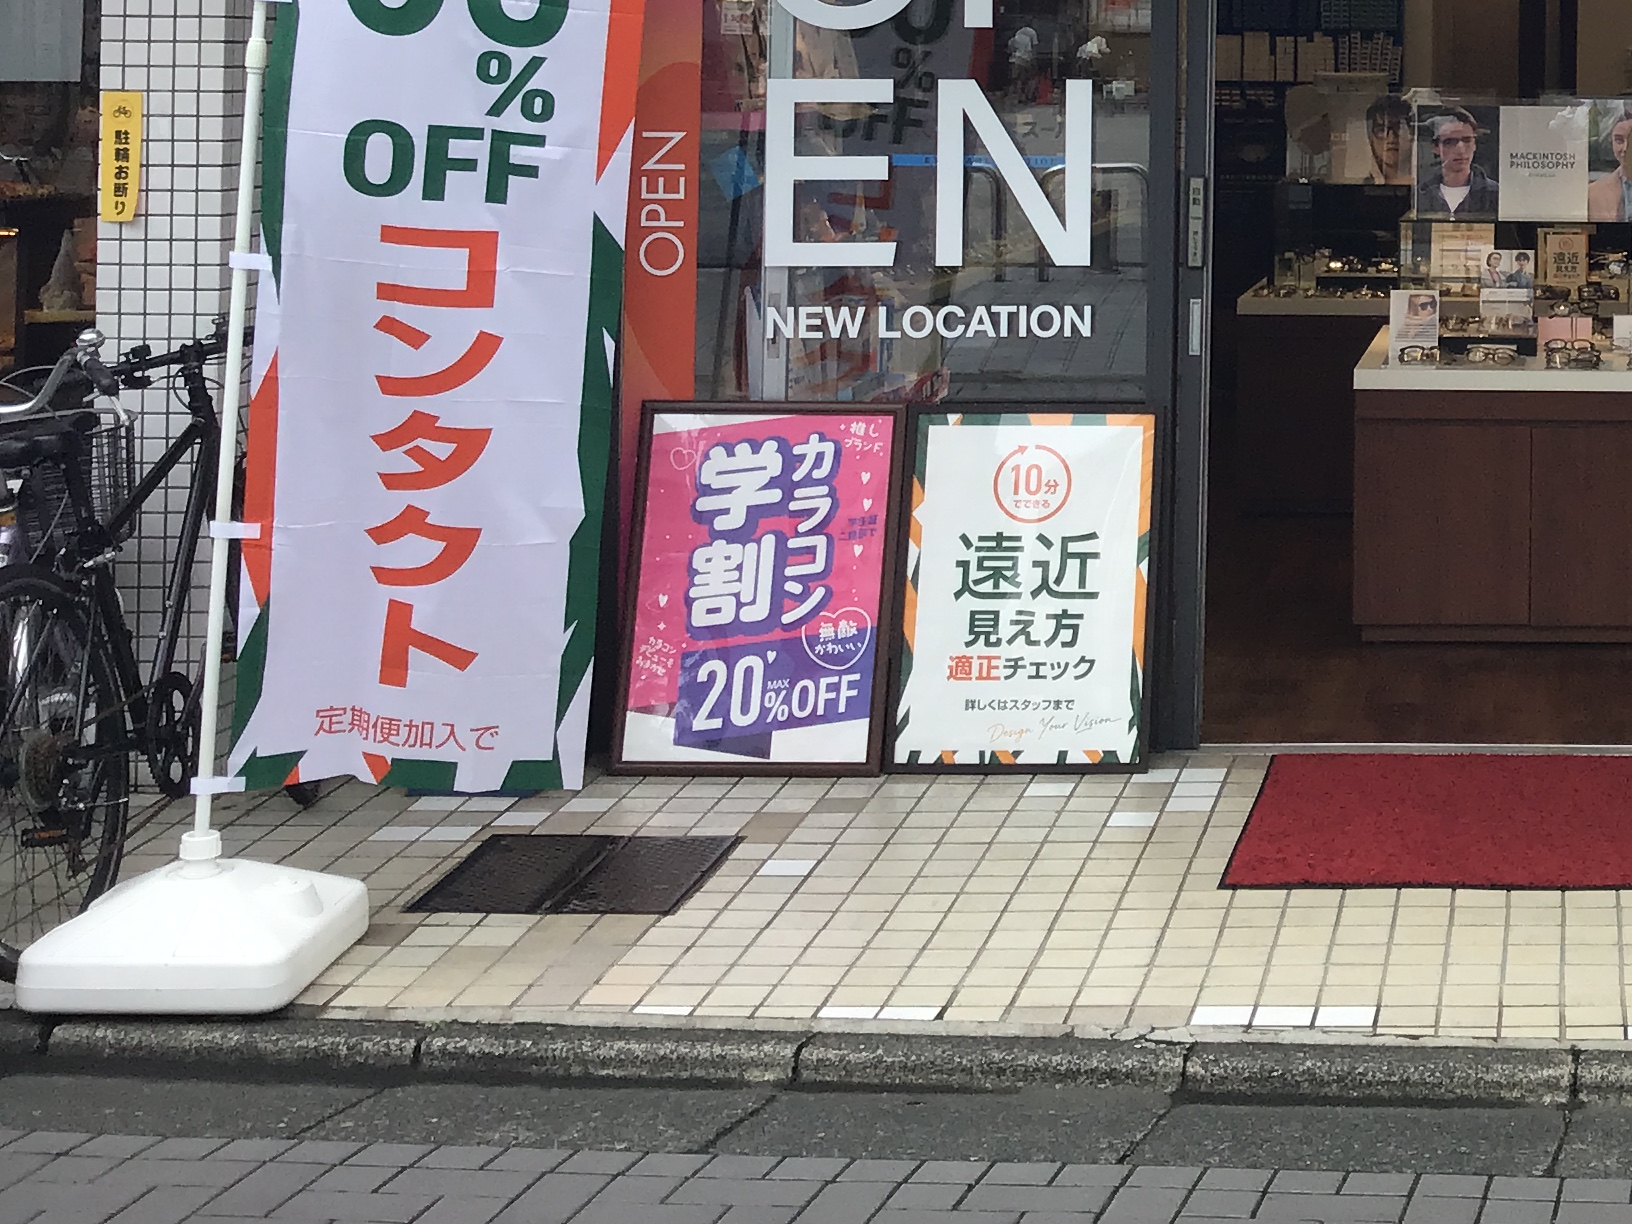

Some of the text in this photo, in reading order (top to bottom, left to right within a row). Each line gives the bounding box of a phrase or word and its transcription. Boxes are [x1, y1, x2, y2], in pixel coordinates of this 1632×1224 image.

[475, 51, 555, 123] %
[114, 129, 130, 216] 駐輪お断り
[343, 119, 547, 205] OFF
[764, 78, 1093, 267] EN
[1509, 152, 1576, 160] MACKINTOSH
[1509, 160, 1576, 169] PHILOSOPHY
[638, 131, 686, 276] OPEN
[766, 305, 1093, 339] NEW LOCATION
[365, 225, 504, 688] コンタクト
[1010, 463, 1060, 496] 10分
[688, 440, 782, 628] 学割
[781, 433, 836, 625] カラコン
[953, 531, 1101, 603] 遠近
[963, 608, 1085, 649] 見え方
[767, 678, 790, 690] MAX
[946, 654, 1097, 682] 適正チェック
[314, 705, 499, 752] 定期便加入で
[964, 699, 1075, 712] 詳しくはスタッフまで
[987, 714, 1122, 744] Design Your Vision
